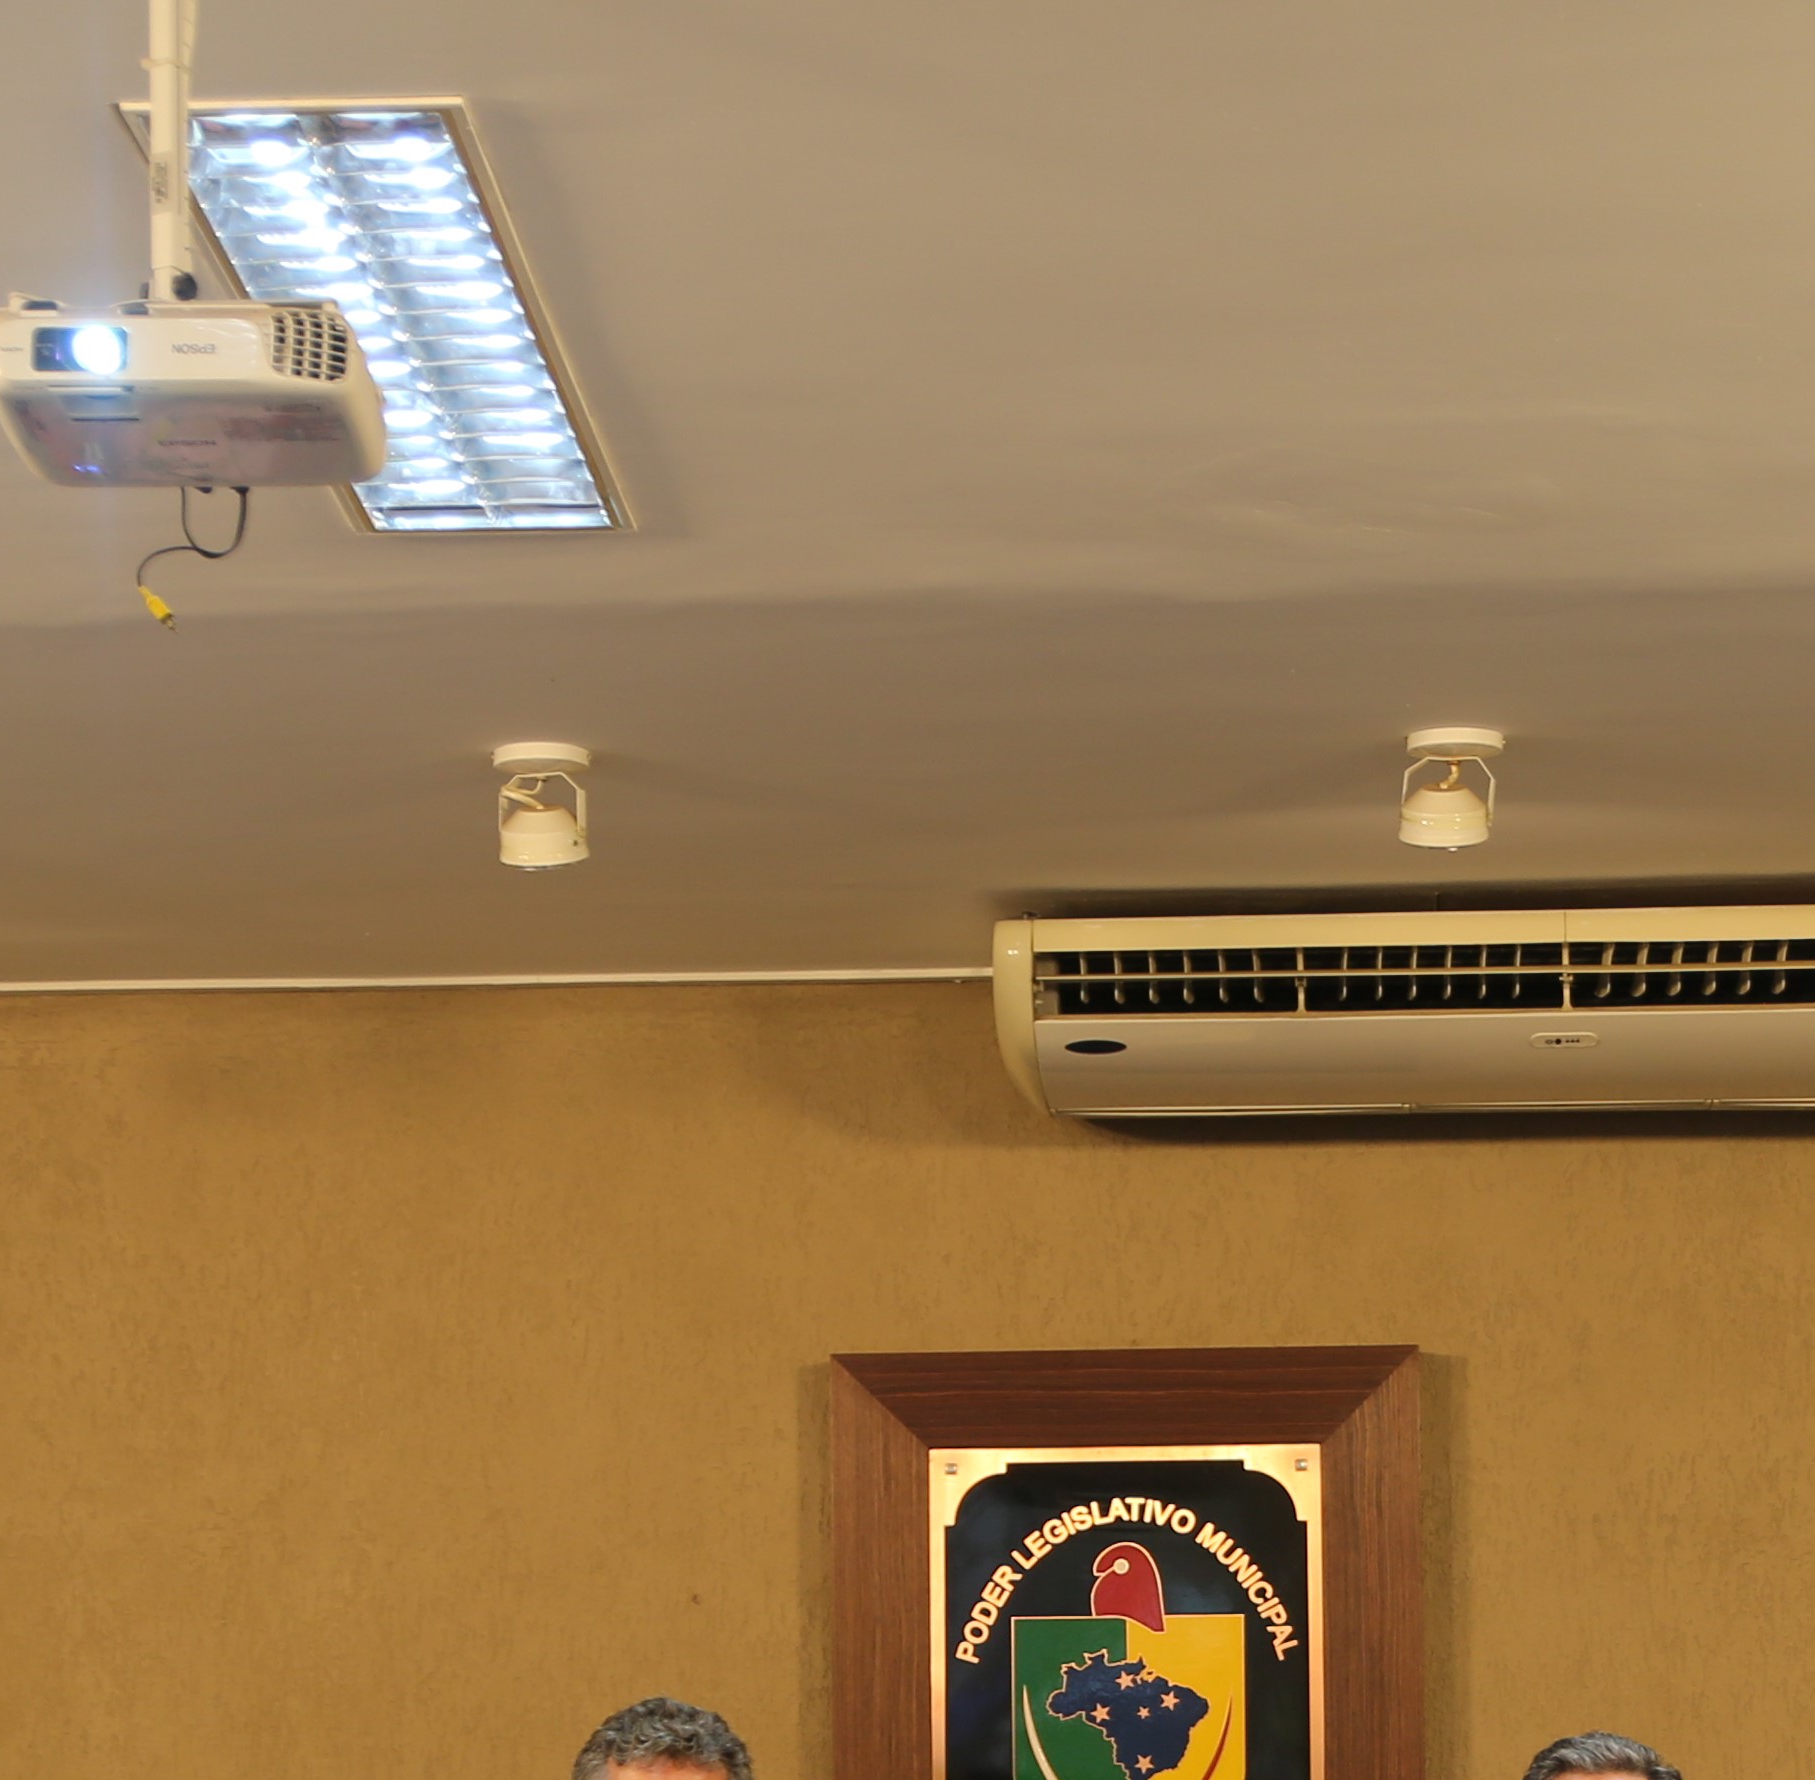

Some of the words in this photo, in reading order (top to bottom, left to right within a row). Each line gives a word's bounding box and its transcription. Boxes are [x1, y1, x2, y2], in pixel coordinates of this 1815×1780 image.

[954, 1564, 1023, 1664] PODER
[1010, 1496, 1197, 1570] LEGISLATIVO
[1194, 1521, 1299, 1662] MUNICIPAL
